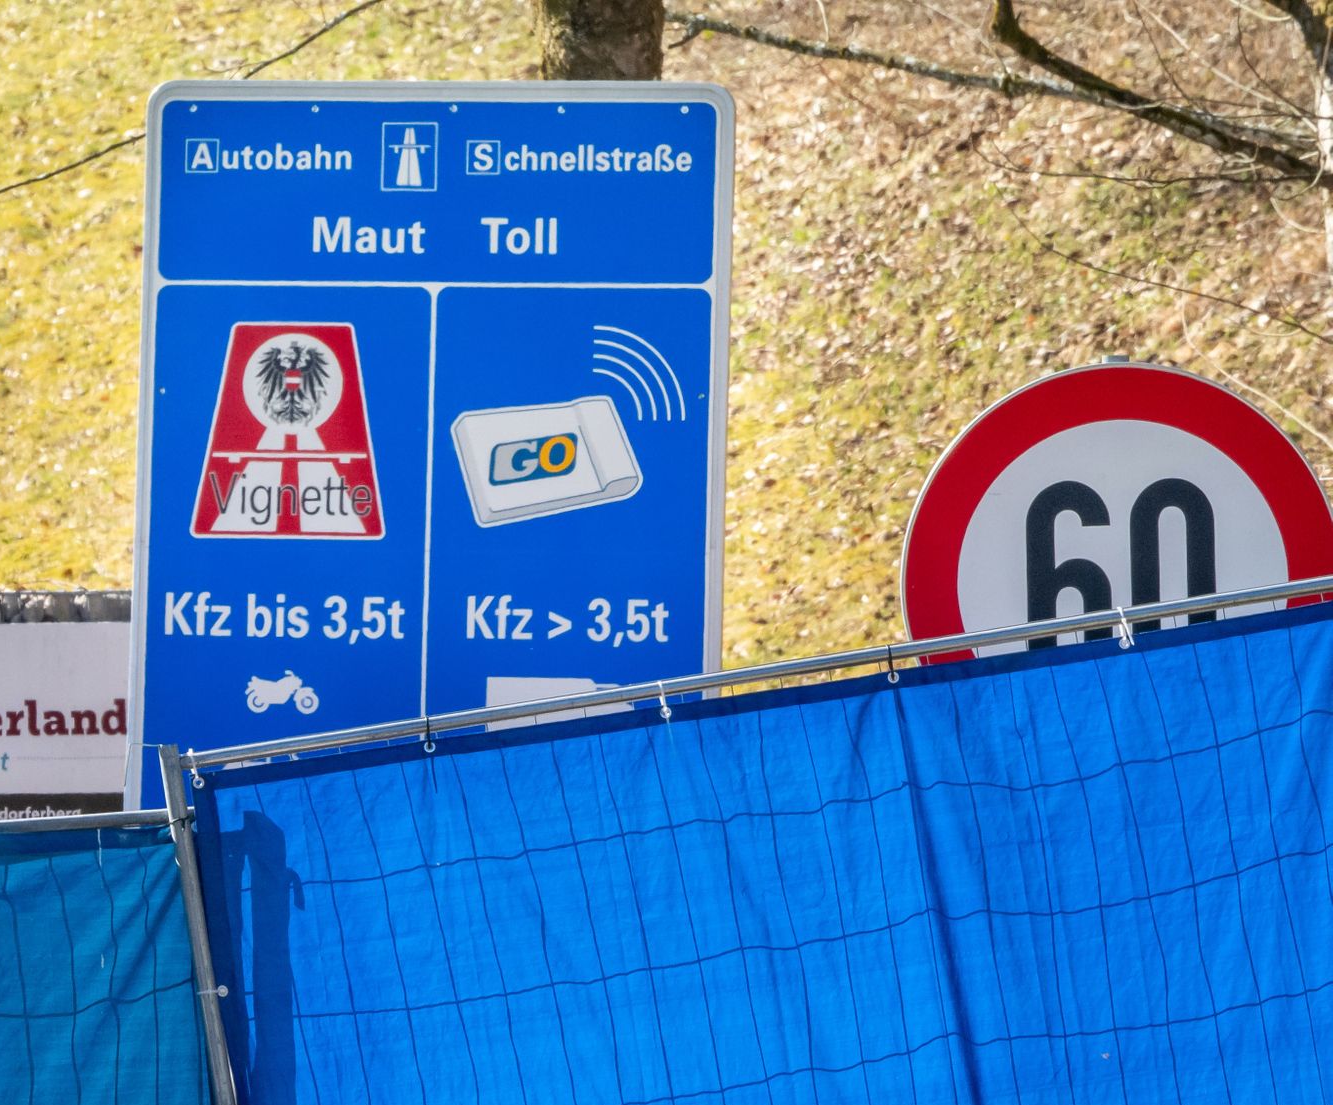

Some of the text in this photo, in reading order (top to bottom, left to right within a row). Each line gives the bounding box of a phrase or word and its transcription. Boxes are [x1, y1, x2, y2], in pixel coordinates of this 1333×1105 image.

[185, 139, 353, 173] Autobahn
[466, 140, 693, 174] Schnellstraße
[312, 216, 558, 255] Maut Toll
[509, 435, 576, 475] GO
[210, 471, 372, 526] Vignette
[1026, 478, 1216, 648] 60
[164, 591, 405, 645] Kfz bis 3,5t
[466, 595, 533, 640] Kfz
[587, 598, 670, 648] 3,5t
